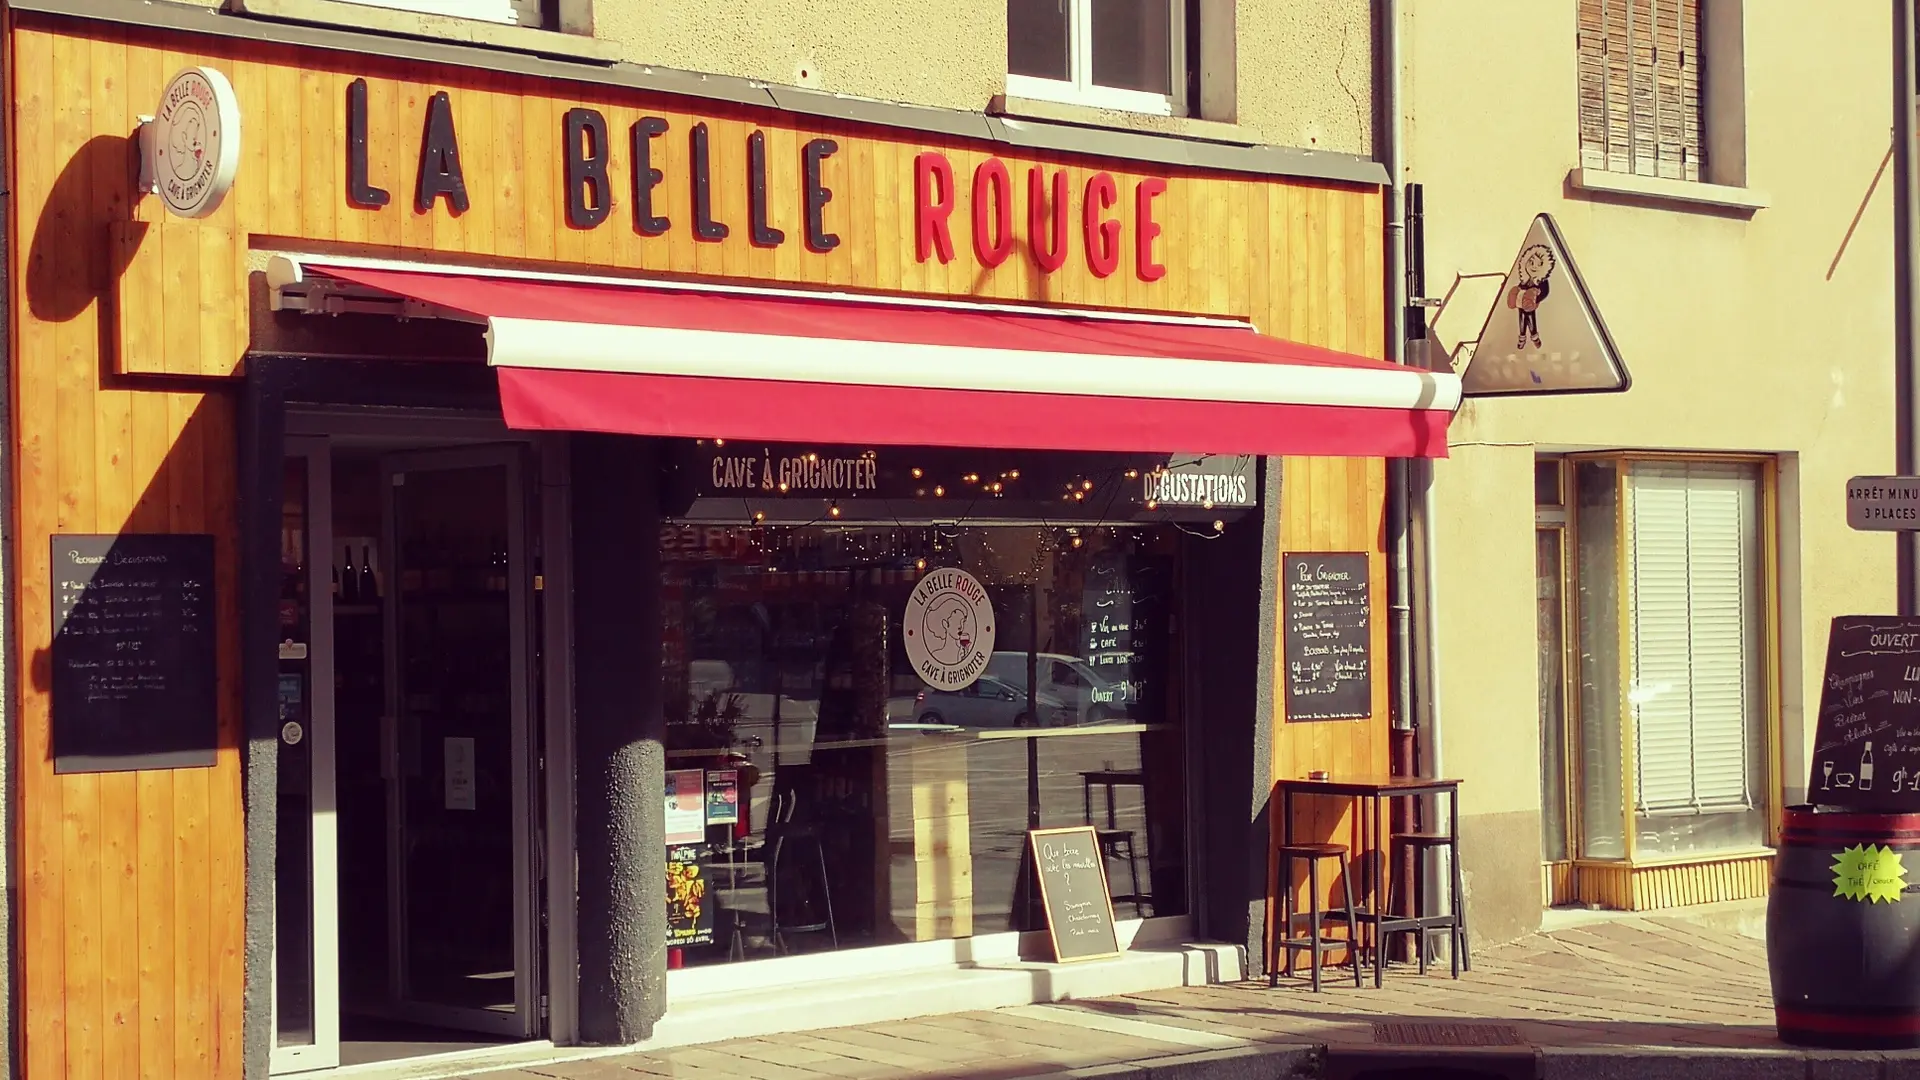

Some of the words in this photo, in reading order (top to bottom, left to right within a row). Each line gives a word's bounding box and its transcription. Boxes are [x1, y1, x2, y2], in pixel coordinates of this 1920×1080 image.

[162, 105, 172, 122] LA
[171, 81, 189, 105] BELLE
[191, 80, 213, 110] ROUGE
[168, 179, 180, 200] CAVE
[186, 159, 213, 200] GRIGNOTER
[348, 77, 470, 215] LA
[567, 107, 840, 250] BELLE
[914, 152, 1167, 281] ROUGE
[712, 456, 756, 488] CAVE
[762, 447, 773, 489] À
[779, 458, 877, 489] GRIGNOTER
[1848, 486, 1884, 499] ARRÊT
[1865, 508, 1870, 519] 3
[1875, 508, 1916, 519] PLACES
[914, 589, 928, 606] LA
[926, 574, 953, 594] BELLE
[955, 575, 986, 606] ROUGE
[1101, 637, 1116, 647] CAFÉ
[1870, 634, 1918, 647] OUVERT
[921, 660, 940, 681] CAVE
[940, 667, 946, 683] À
[948, 651, 985, 684] GRIGNOTER
[1828, 669, 1875, 690] Champagnes
[1092, 687, 1113, 702] OUVERT
[1893, 688, 1920, 704] NON-
[1857, 859, 1879, 871] CAFÉ
[1848, 874, 1864, 886] THÉ
